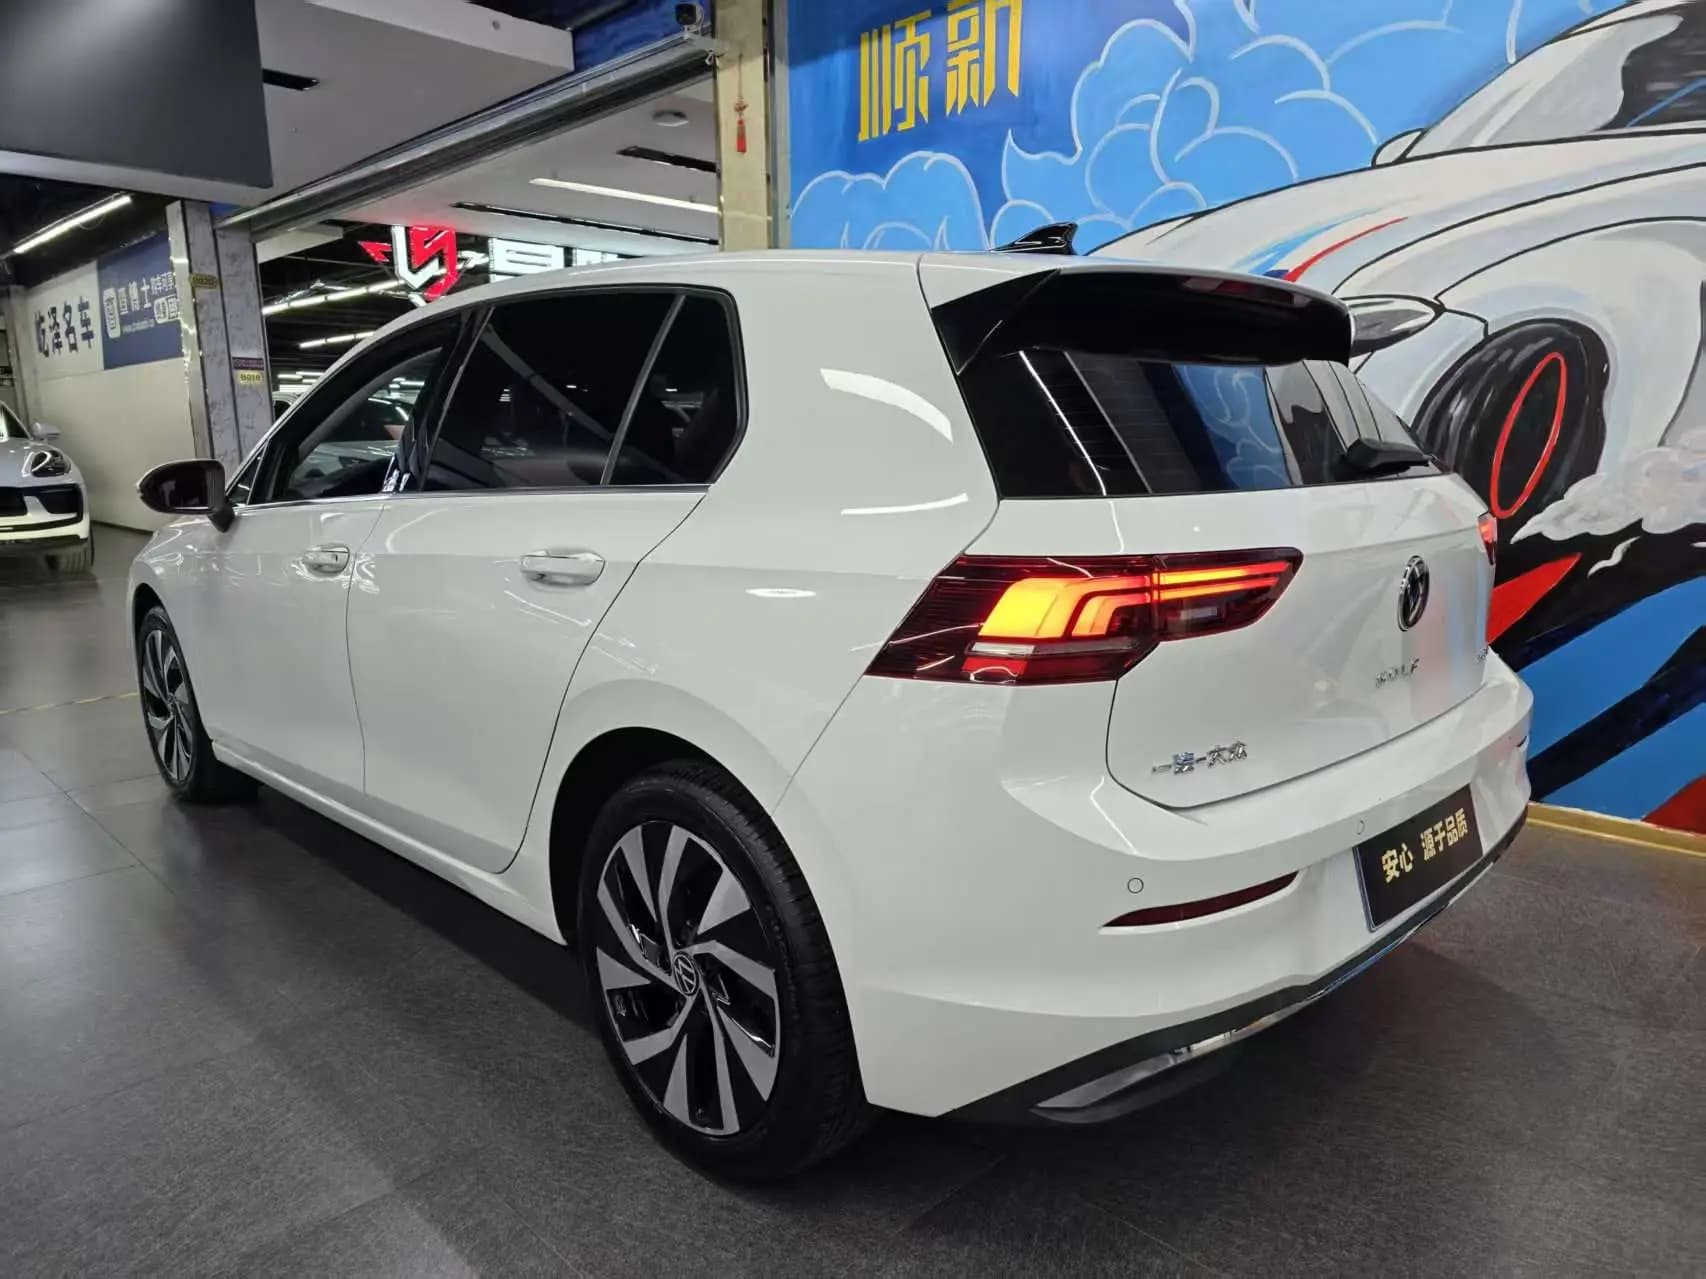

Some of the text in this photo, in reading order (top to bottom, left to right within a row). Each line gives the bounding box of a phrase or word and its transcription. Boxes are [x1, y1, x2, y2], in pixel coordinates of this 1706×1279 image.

[1381, 807, 1468, 883] 安心 源于品质
